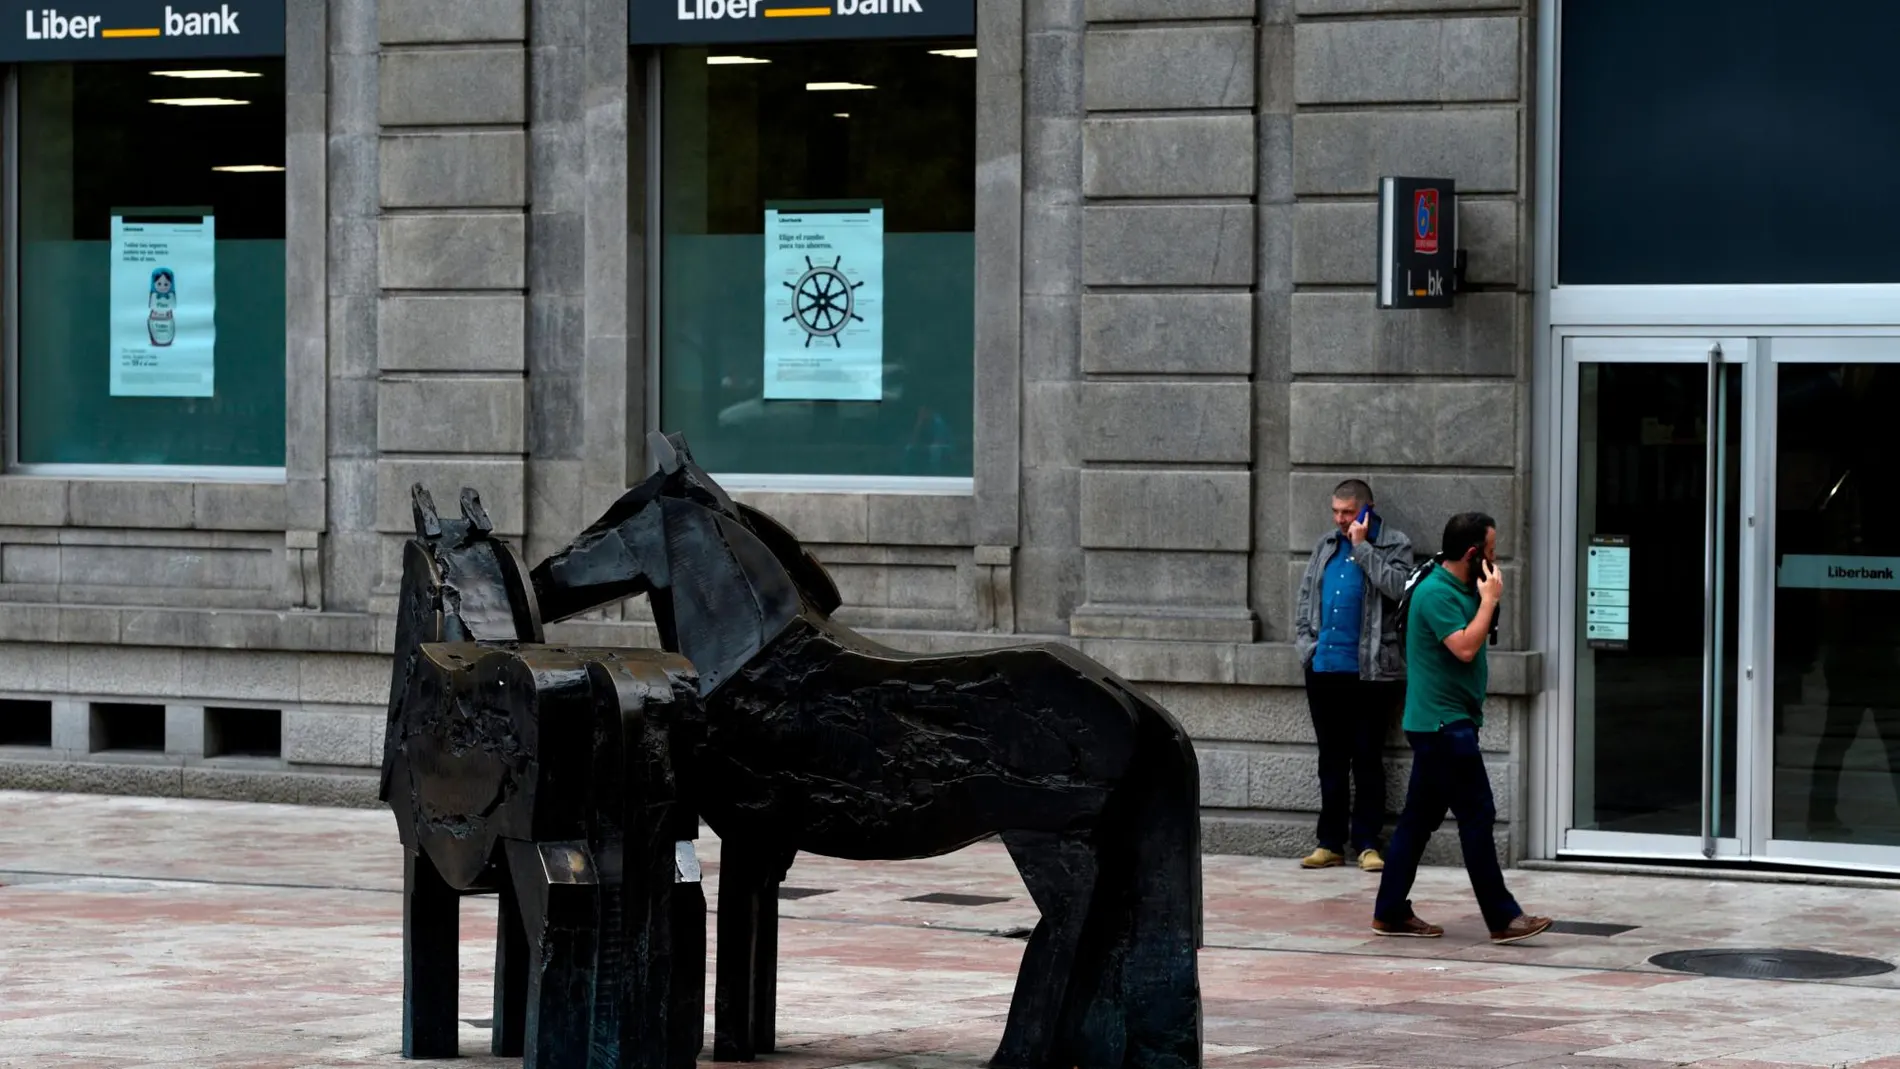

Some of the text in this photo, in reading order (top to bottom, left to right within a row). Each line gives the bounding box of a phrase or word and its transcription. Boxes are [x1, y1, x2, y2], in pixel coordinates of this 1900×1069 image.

[26, 4, 240, 40] Liber bank
[1428, 269, 1443, 296] bk
[1828, 565, 1893, 579] Liberbank
